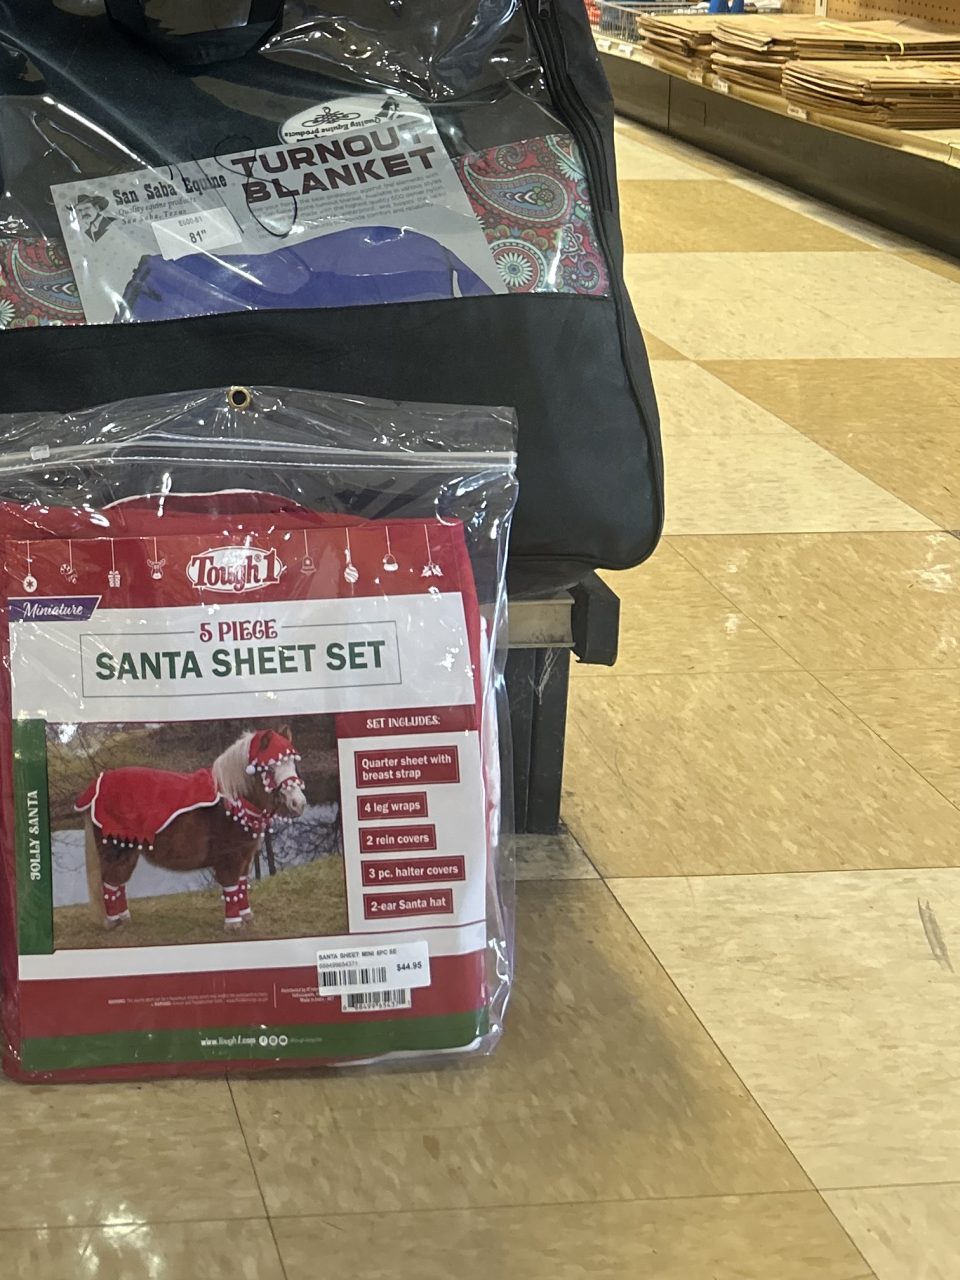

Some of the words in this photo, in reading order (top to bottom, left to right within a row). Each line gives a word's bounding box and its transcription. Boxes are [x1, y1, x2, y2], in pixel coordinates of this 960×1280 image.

[284, 128, 320, 137] products
[321, 123, 349, 133] Equine
[232, 121, 430, 177] TURNOU
[242, 145, 435, 204] BLANKET
[112, 189, 139, 206] San
[144, 181, 177, 200] Saba
[184, 174, 227, 196] Equine
[189, 229, 207, 244] 81"
[23, 601, 84, 618] Miniature
[200, 623, 213, 642] 5
[218, 619, 278, 642] PIECE
[95, 650, 203, 681] SANTA
[211, 644, 316, 677] SHEET
[326, 640, 385, 670] SET
[366, 718, 385, 729] SET
[388, 715, 441, 728] INCLUDES:
[362, 758, 398, 769] Quarter
[400, 755, 428, 766] sheet
[430, 754, 452, 764] with
[362, 769, 394, 780] breast
[396, 769, 421, 779] strap
[27, 790, 39, 835] SANTA
[364, 803, 371, 813] 4
[373, 802, 389, 814] leg
[391, 801, 421, 812] wraps
[366, 835, 373, 845] 2
[376, 834, 394, 845] rein
[397, 834, 429, 844] covers
[30, 838, 41, 880] JOLLY
[368, 868, 375, 878] 3
[378, 870, 393, 880] pc.
[395, 867, 424, 877] halter
[426, 865, 458, 875] covers
[371, 901, 397, 911] 2-ear
[399, 899, 427, 910] Santa
[429, 897, 446, 907] hat
[340, 951, 359, 959] SHEET
[396, 960, 422, 971] $44.95
